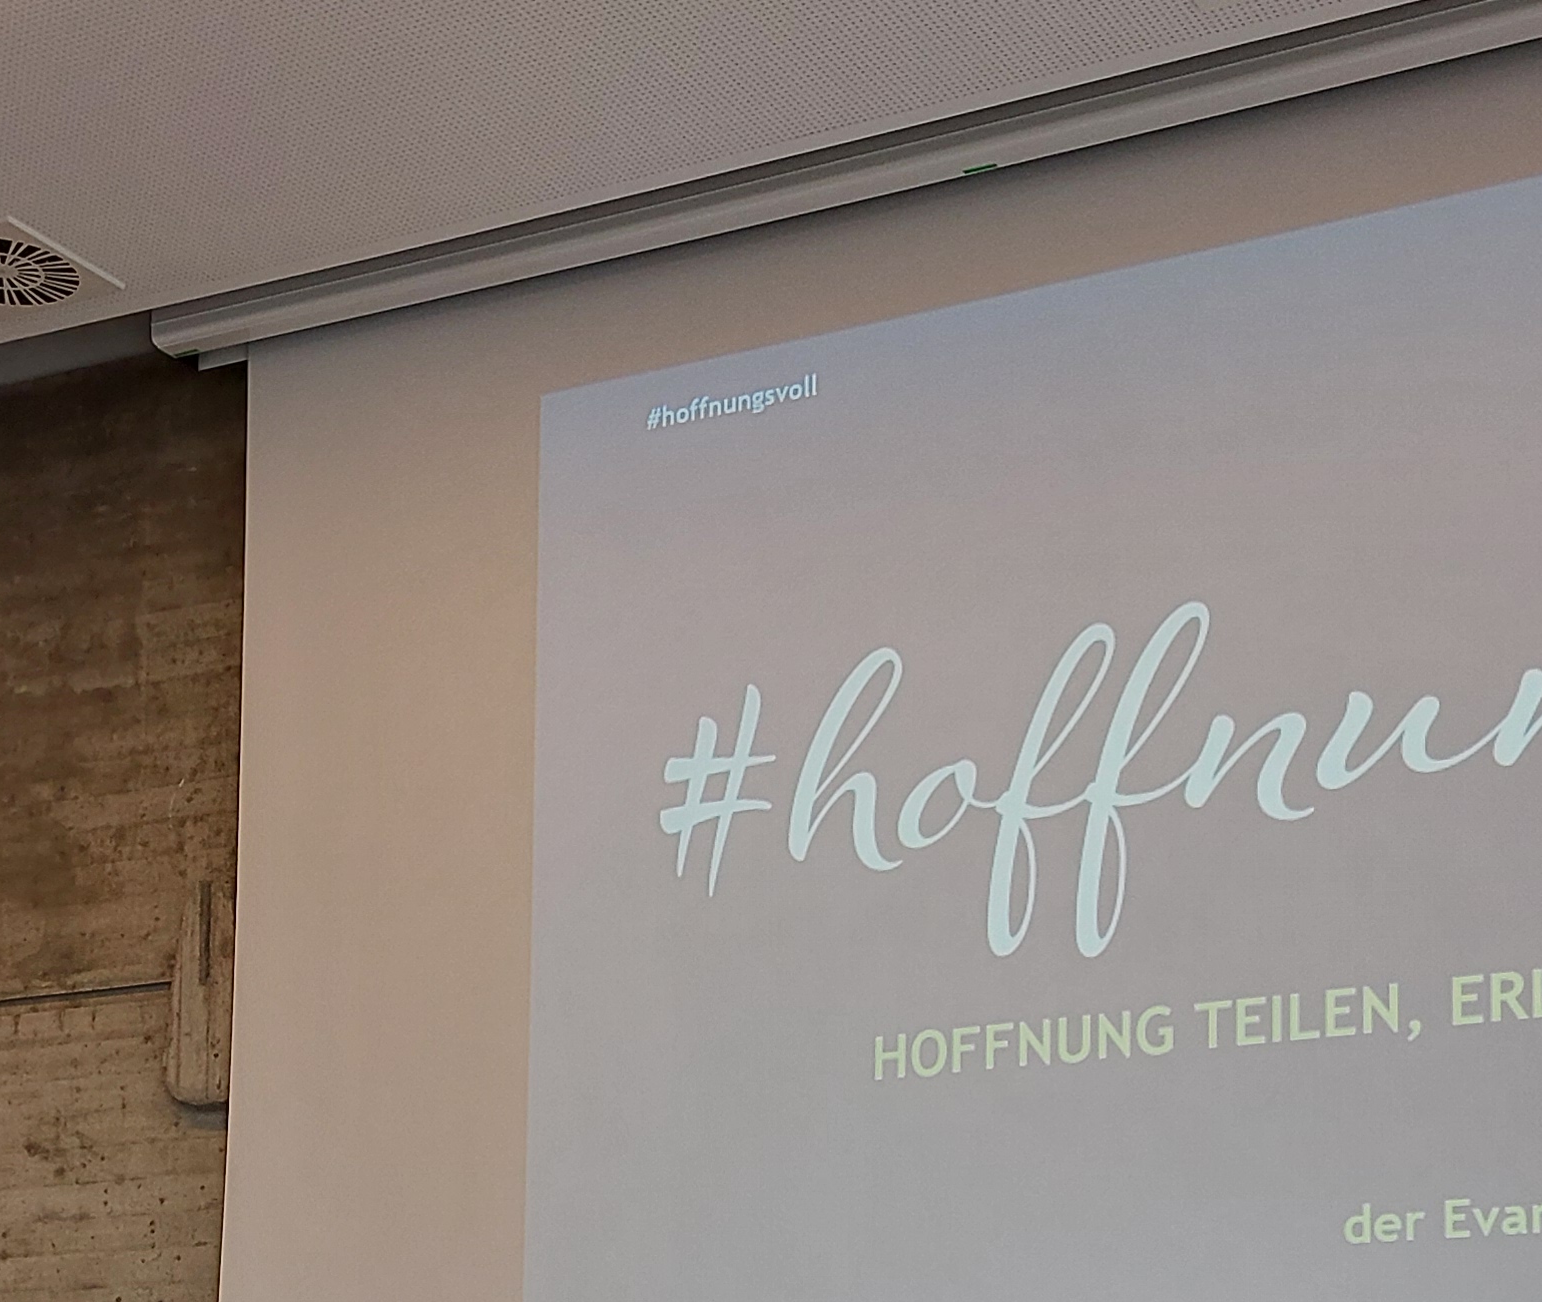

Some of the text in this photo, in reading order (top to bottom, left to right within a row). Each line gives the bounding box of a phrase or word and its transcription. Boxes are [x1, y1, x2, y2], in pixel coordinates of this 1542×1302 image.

[646, 372, 818, 431] #hoffnungsvoll
[873, 1004, 1175, 1081] HOFFNUNG
[1193, 982, 1424, 1049] TEILEN,
[1343, 1202, 1427, 1245] der
